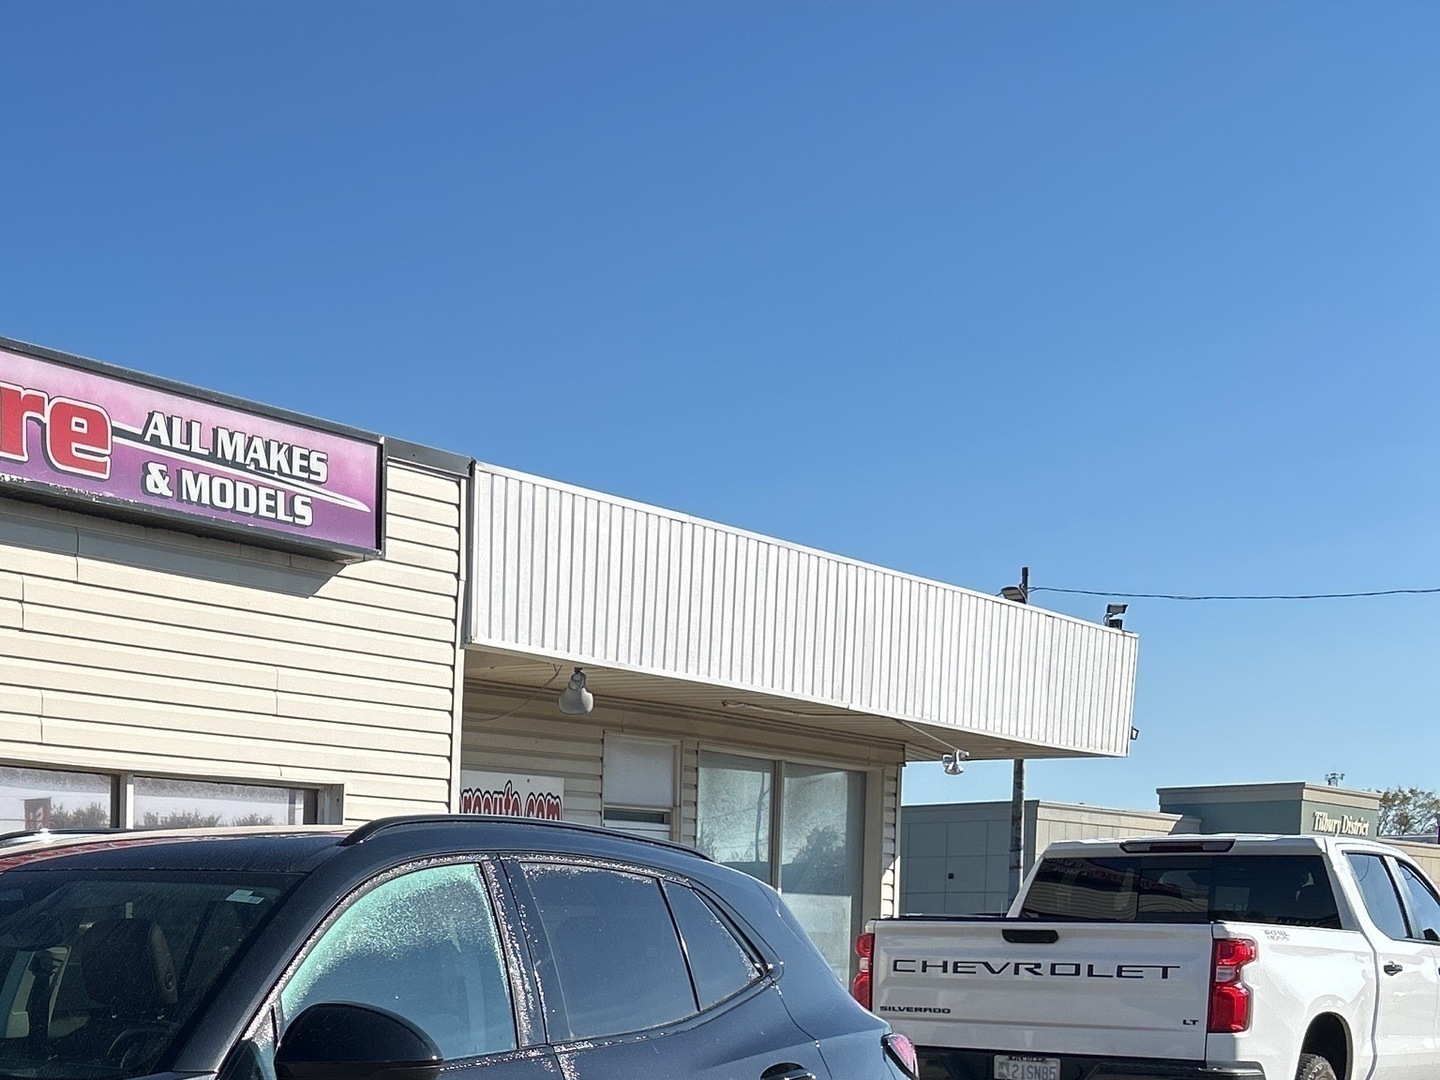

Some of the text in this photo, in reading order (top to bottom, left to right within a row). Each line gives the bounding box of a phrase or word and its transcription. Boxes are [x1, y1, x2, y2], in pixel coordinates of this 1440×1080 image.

[144, 411, 328, 484] ALL MAKES
[145, 462, 313, 527] & MODELS
[1314, 811, 1370, 837] Tilbury District
[893, 959, 1181, 980] CHEVROLET
[879, 1005, 951, 1015] SILVERADO
[1182, 1019, 1199, 1027] LT
